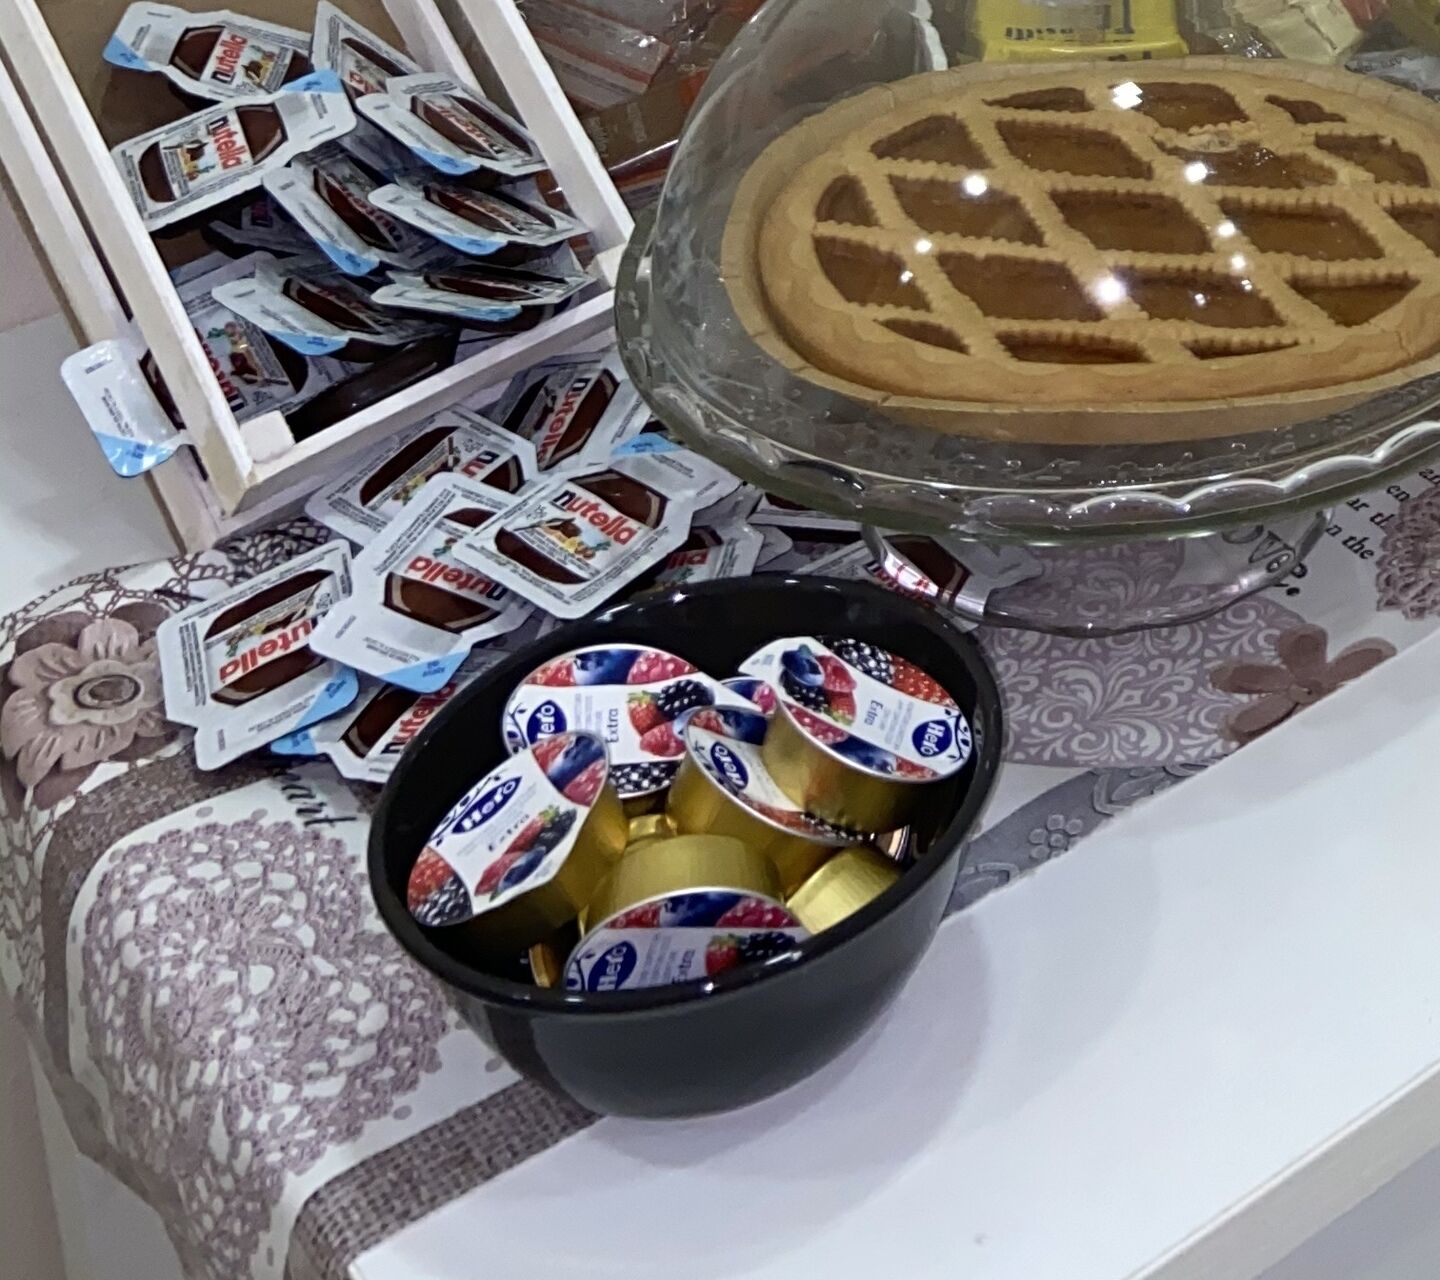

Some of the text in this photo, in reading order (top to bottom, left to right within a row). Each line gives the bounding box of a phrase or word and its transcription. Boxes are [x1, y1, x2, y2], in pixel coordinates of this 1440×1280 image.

[211, 34, 248, 85] nutella
[206, 115, 248, 170] nutella
[537, 376, 592, 465] nutella
[552, 490, 639, 546] nutella
[1341, 533, 1376, 560] the
[406, 555, 507, 602] nutella
[218, 618, 316, 682] utella
[921, 721, 945, 756] Hero
[715, 744, 746, 788] Hero
[461, 780, 516, 832] Hero
[597, 945, 627, 991] Hero
